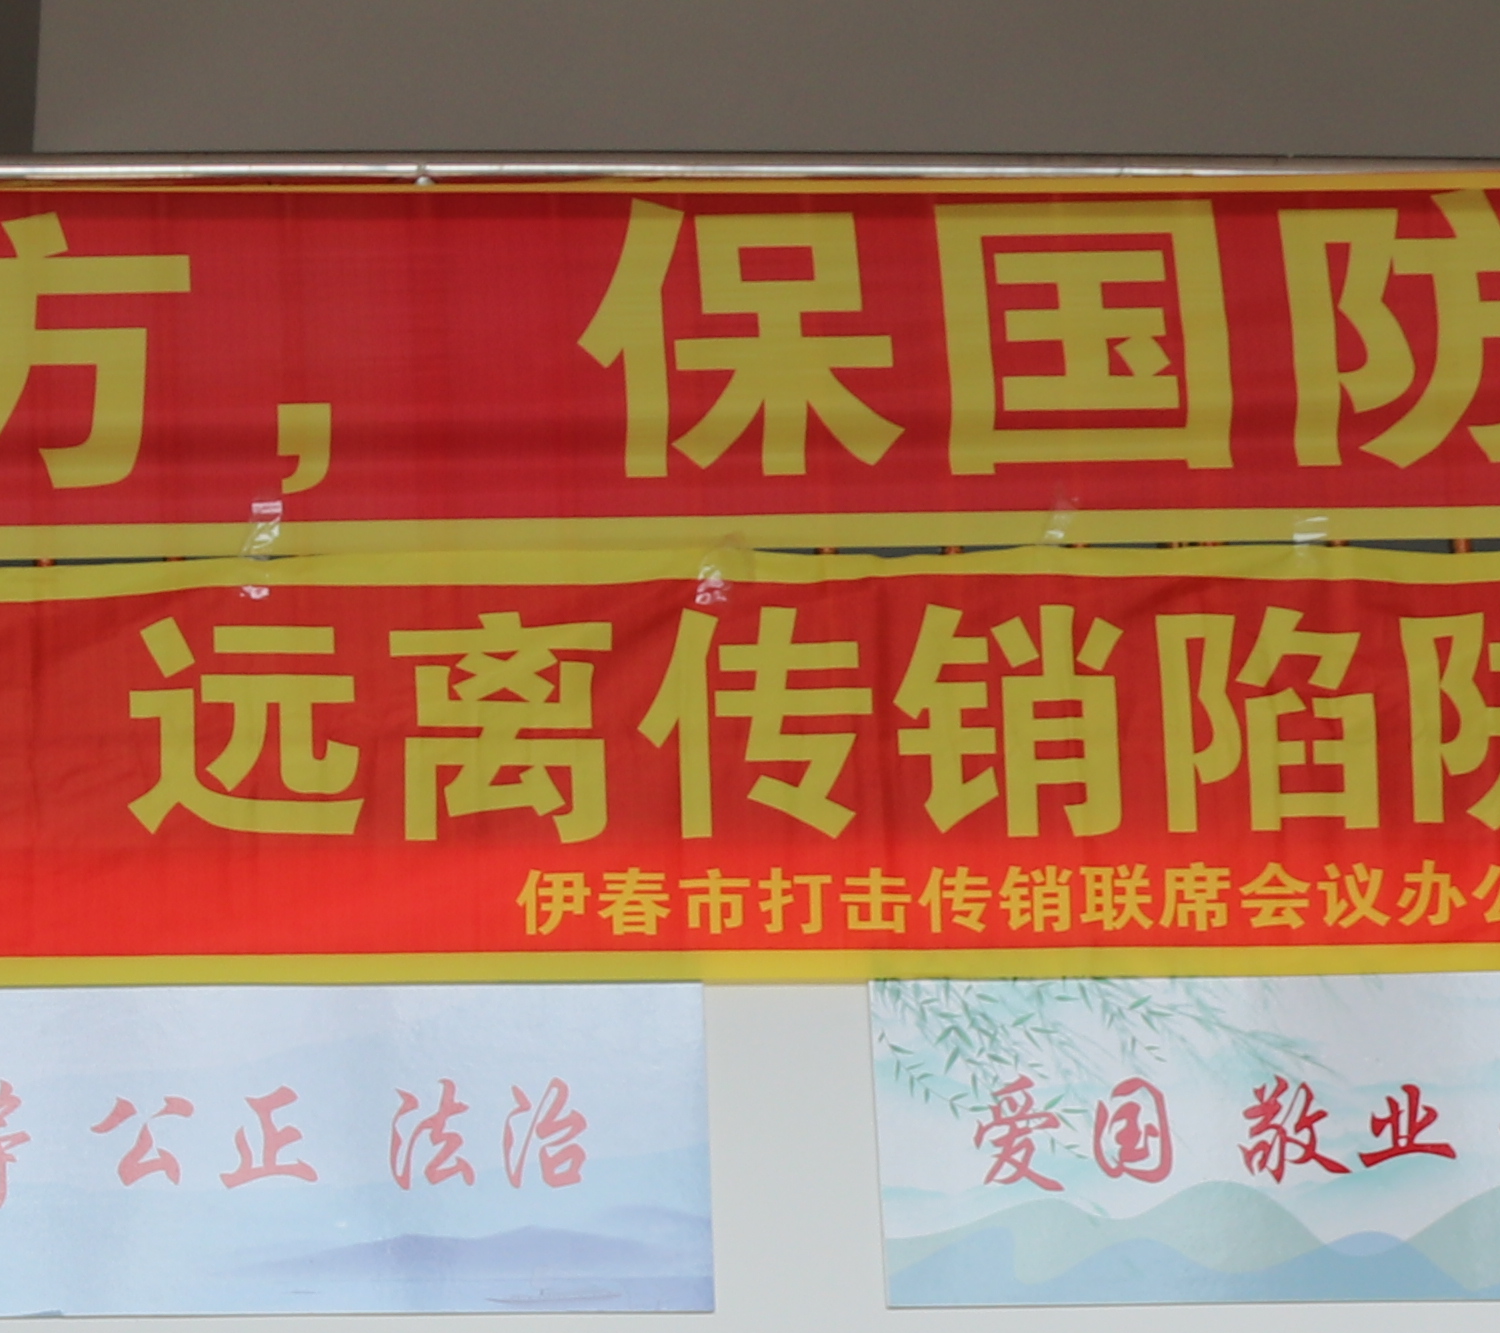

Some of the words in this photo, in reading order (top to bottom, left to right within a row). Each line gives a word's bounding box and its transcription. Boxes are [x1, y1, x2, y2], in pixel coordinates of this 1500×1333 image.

[92, 1085, 320, 1190] 公正
[388, 1077, 590, 1192] 法治
[972, 1074, 1174, 1193] 爱国
[1238, 1074, 1458, 1184] 敬业
